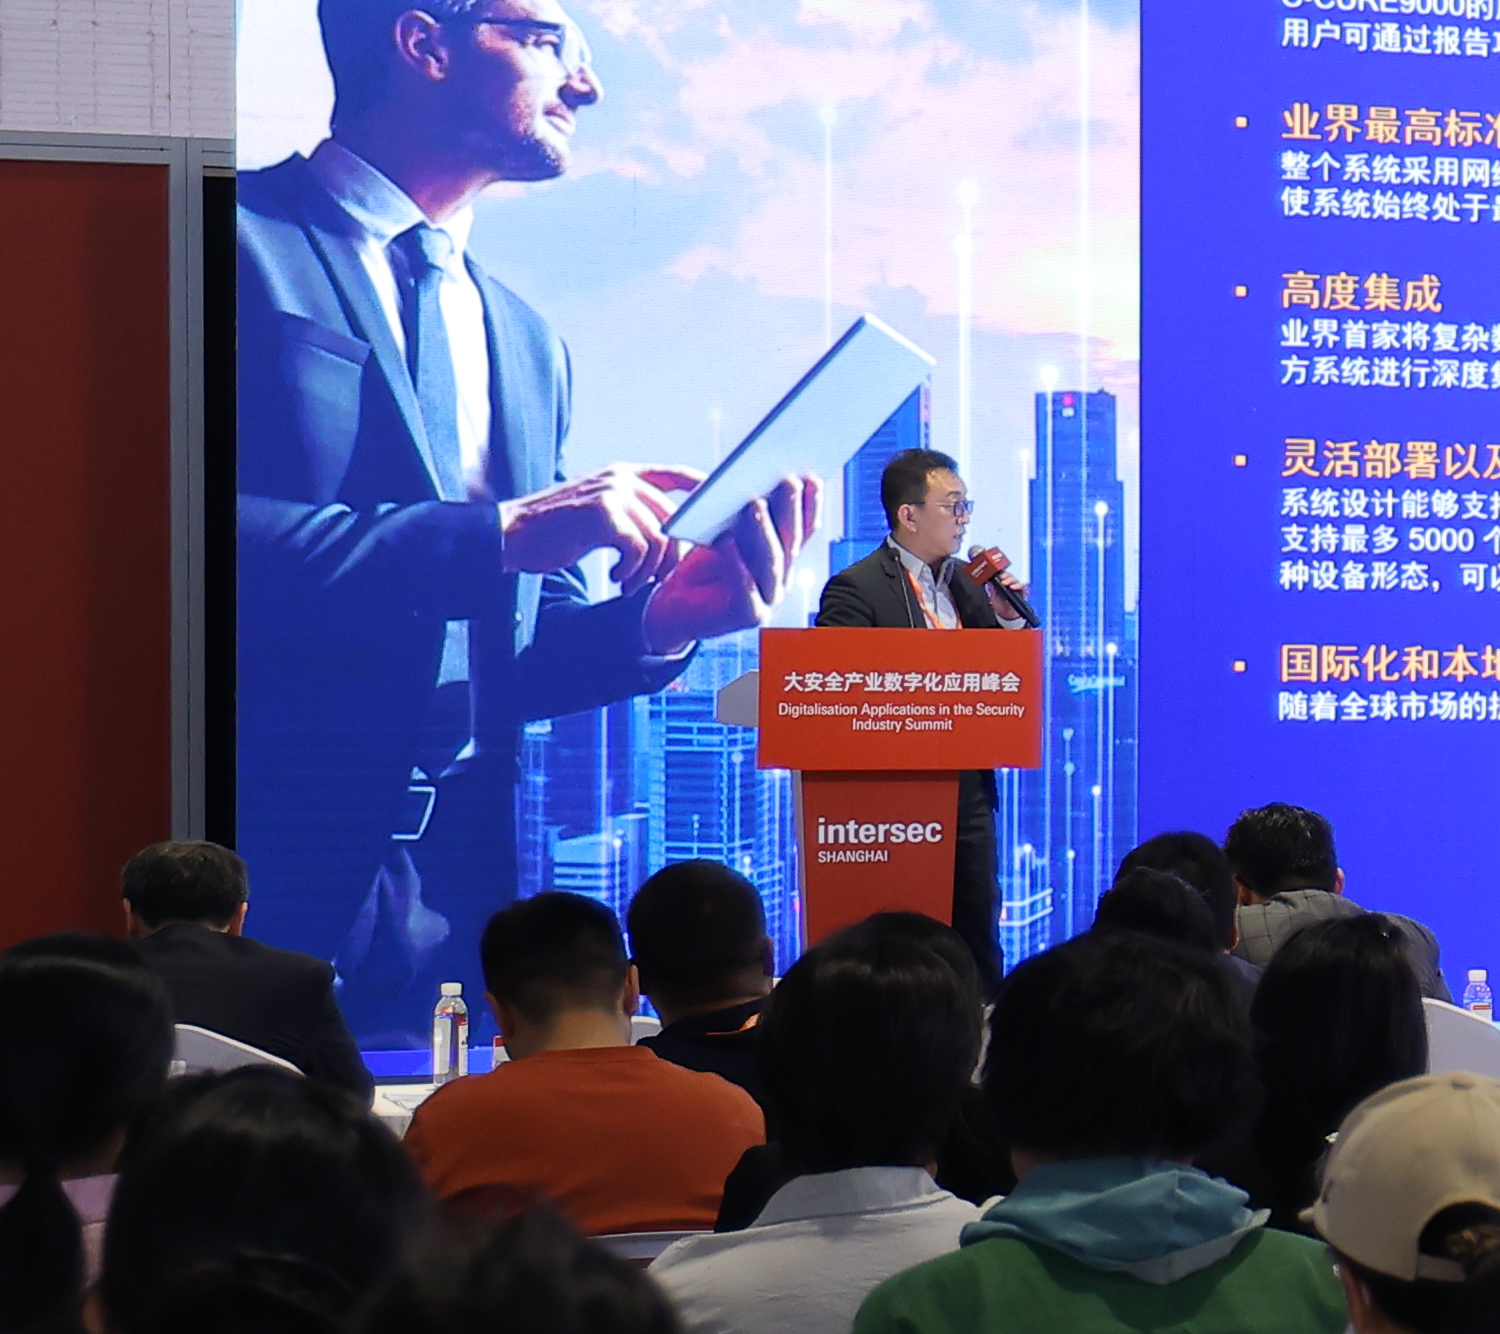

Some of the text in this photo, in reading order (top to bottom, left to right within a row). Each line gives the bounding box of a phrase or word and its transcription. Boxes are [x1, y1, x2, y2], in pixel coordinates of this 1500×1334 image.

[1281, 271, 1443, 314] 高度集成
[1280, 524, 1399, 554] 支持最多
[1409, 527, 1475, 553] 5000
[784, 672, 1021, 693] 大安全产业数字化应用峰会
[778, 702, 1025, 718] Digitalisation Applications in the Security
[852, 718, 953, 733] Industry Summit
[817, 818, 943, 844] intersec
[817, 851, 889, 863] SHANGHAI
